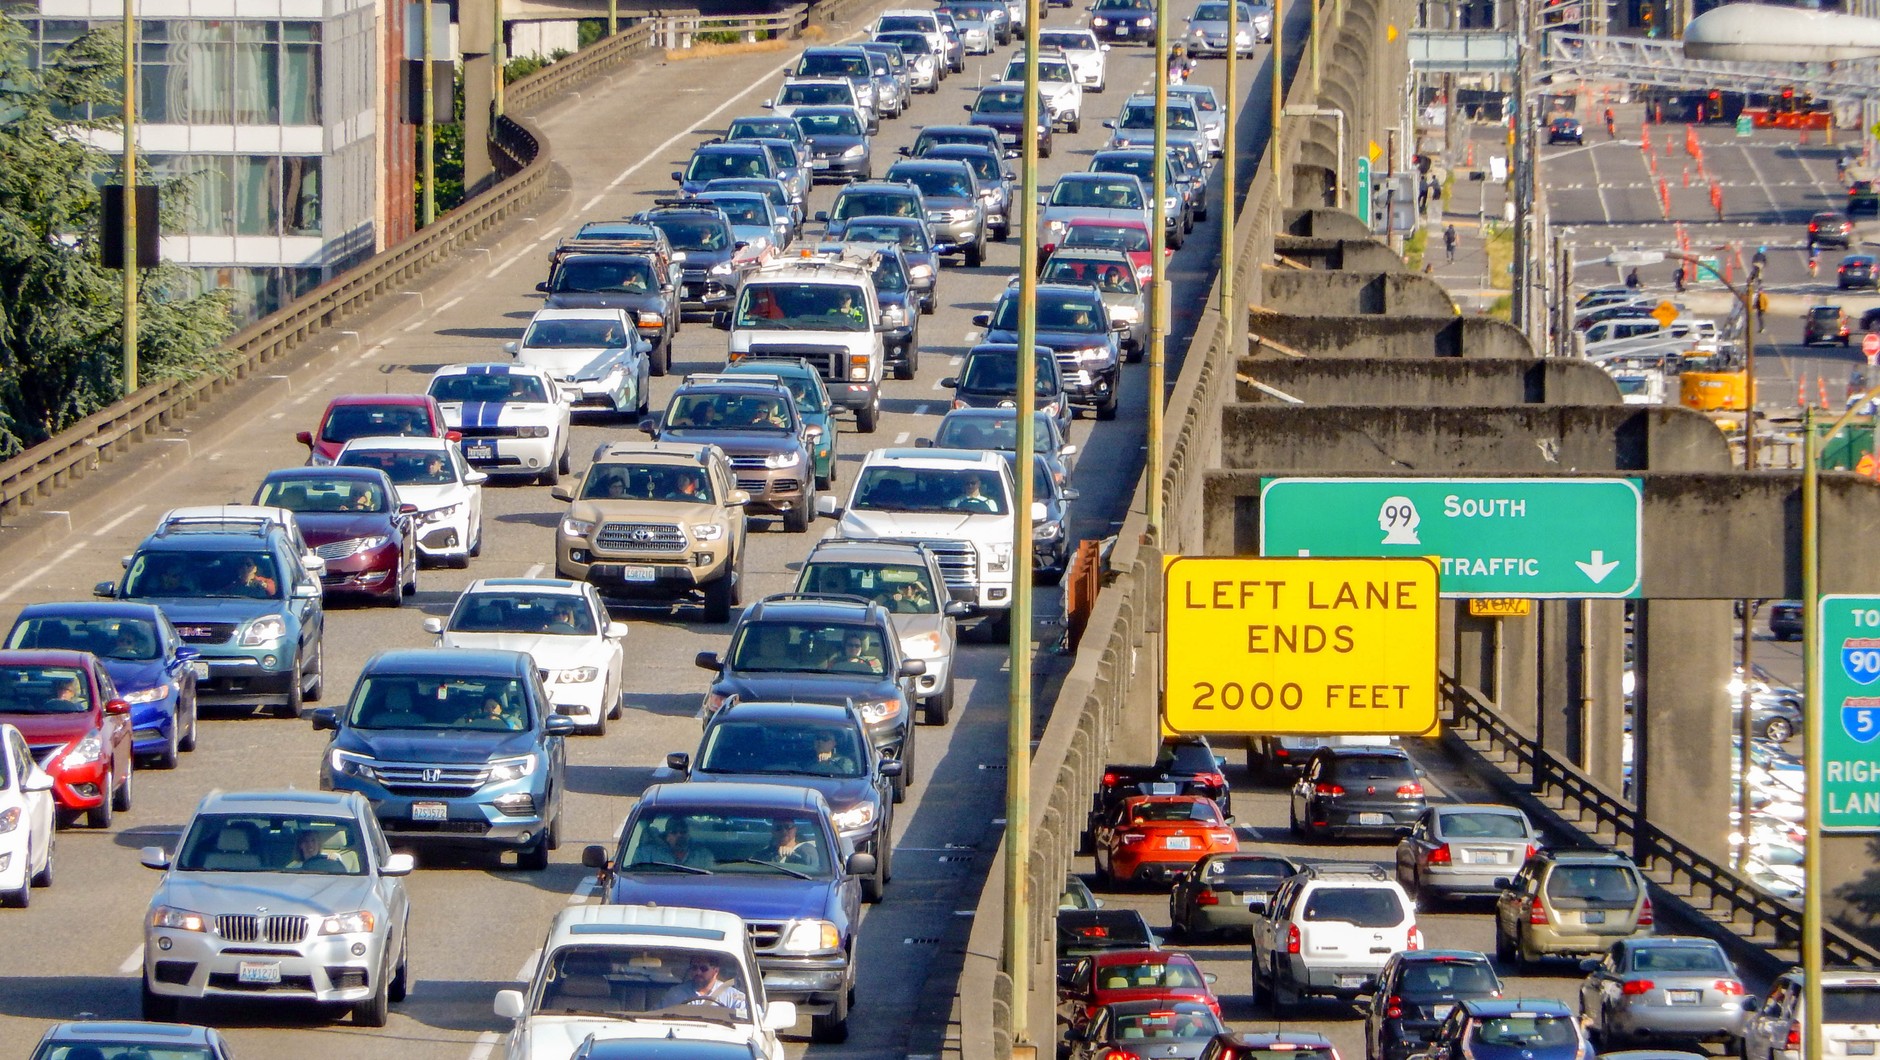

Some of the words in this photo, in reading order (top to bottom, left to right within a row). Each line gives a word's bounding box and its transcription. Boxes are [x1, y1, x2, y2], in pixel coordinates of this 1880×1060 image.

[1385, 505, 1412, 527] 99
[1443, 495, 1526, 518] SOUTH
[1441, 557, 1539, 576] TRAFFIC
[1185, 580, 1286, 609] LEFT
[1308, 581, 1417, 610] LANE
[1851, 609, 1880, 627] TO
[1247, 625, 1355, 654] ENDS
[1849, 651, 1880, 674] 90
[1192, 681, 1304, 711] 2000
[1326, 684, 1410, 709] FEET
[1856, 710, 1874, 733] 5
[1827, 760, 1880, 782] RIGH
[1829, 792, 1880, 814] LAN
